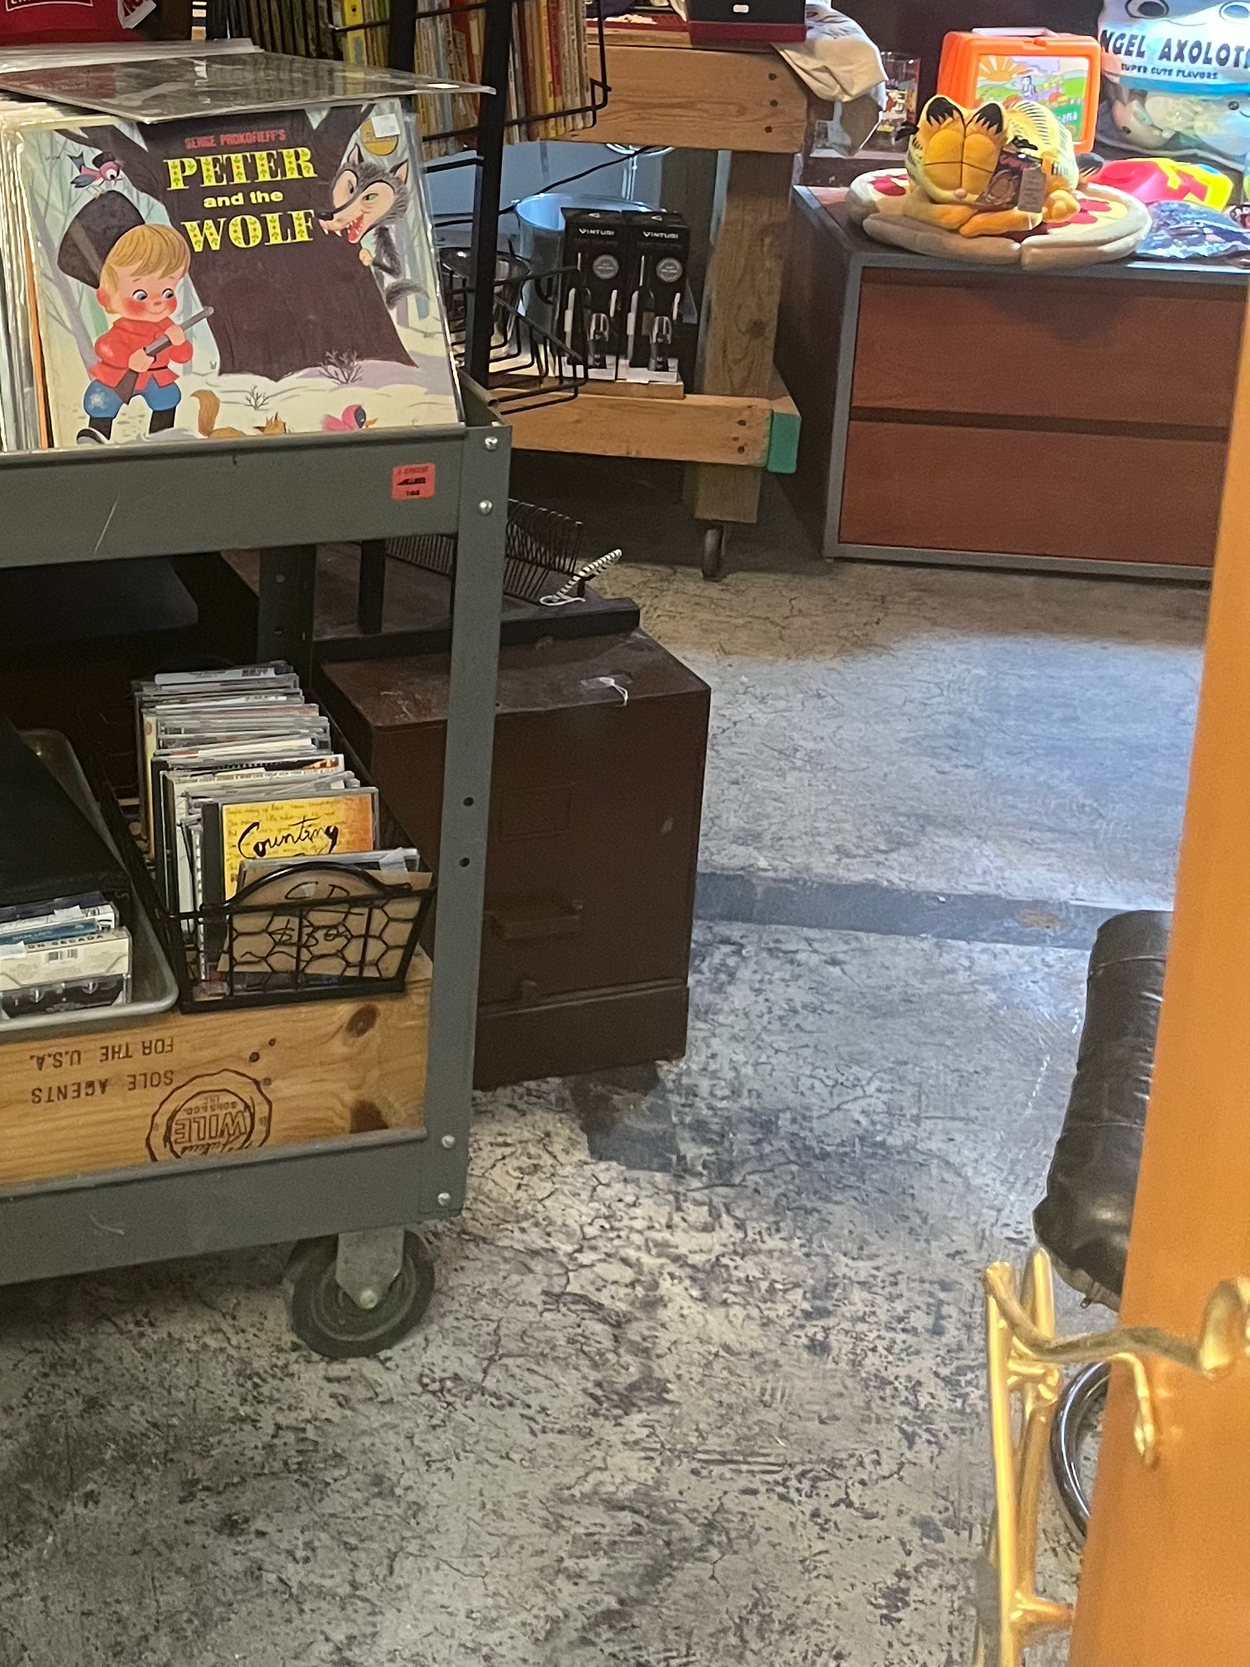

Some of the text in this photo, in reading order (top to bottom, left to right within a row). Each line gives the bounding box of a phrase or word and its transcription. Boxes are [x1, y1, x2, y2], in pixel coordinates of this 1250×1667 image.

[1100, 29, 1146, 59] NGEL
[1121, 63, 1218, 80] SUPER CUTE FLAVORS
[184, 135, 217, 150] SERGE
[163, 147, 318, 191] PETER
[203, 190, 284, 209] and the
[181, 209, 315, 253] WOLF
[578, 228, 615, 236] VINTURI
[642, 231, 679, 239] VINTURI
[238, 816, 339, 860] Counting
[28, 935, 104, 950] ON SECADA
[30, 1037, 174, 1071] FOR THE U.S.A.
[31, 1070, 174, 1105] SOLE AGENTS
[174, 1110, 248, 1145] WILE
